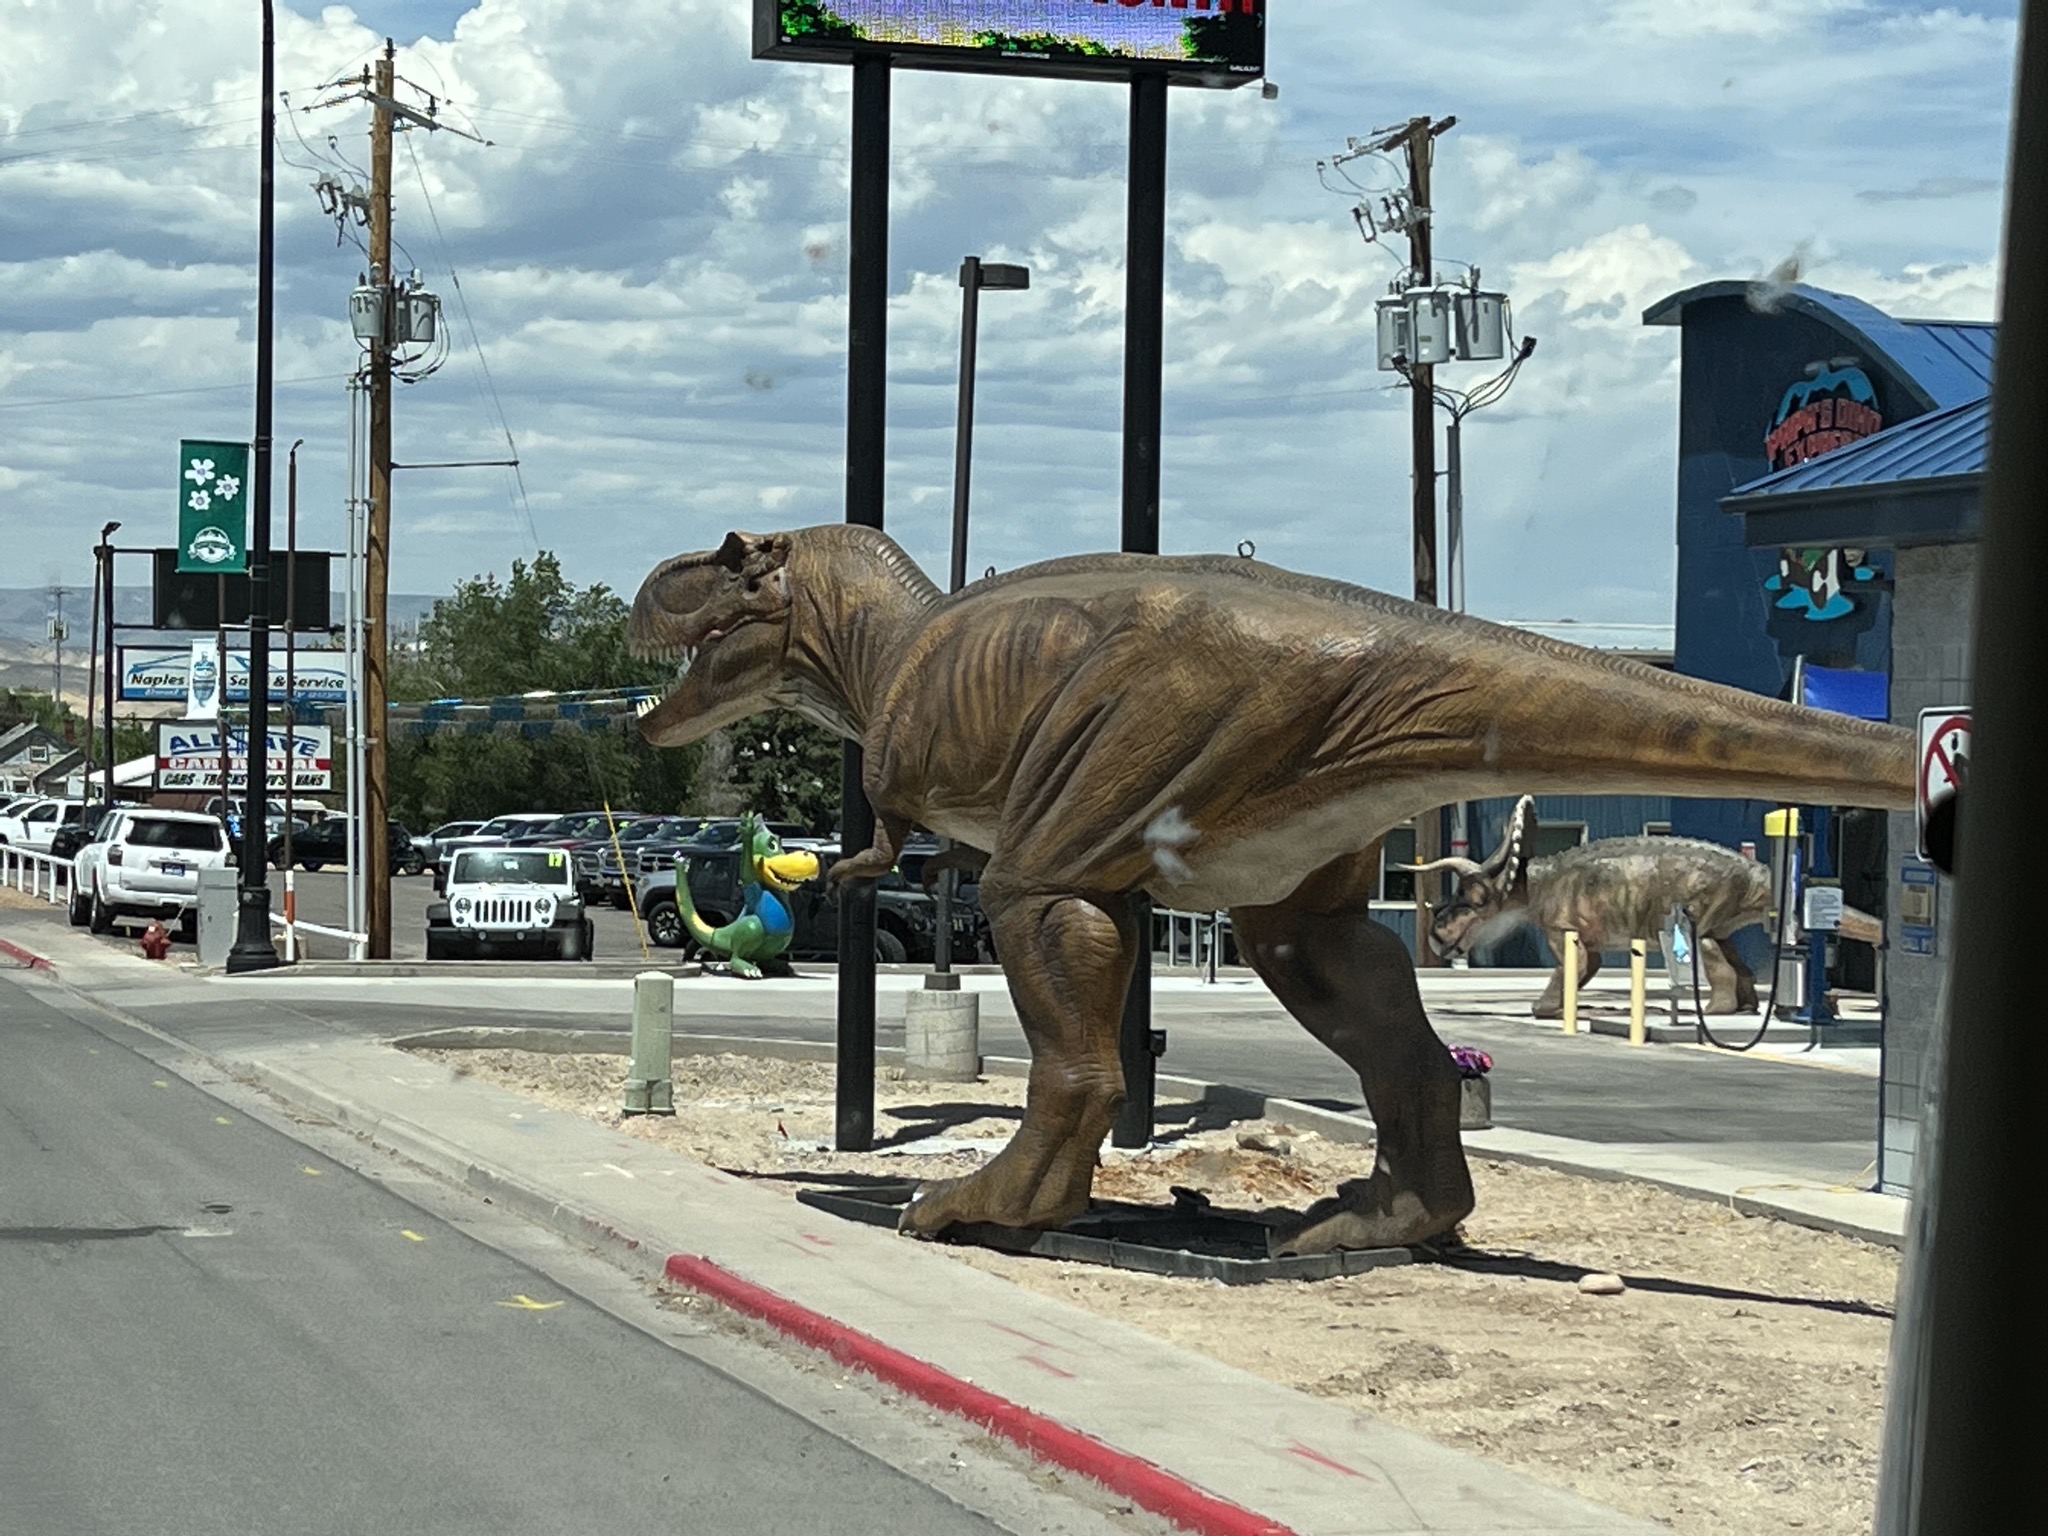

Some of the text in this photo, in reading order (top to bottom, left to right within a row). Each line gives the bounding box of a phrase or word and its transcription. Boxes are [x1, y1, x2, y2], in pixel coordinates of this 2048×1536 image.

[130, 673, 186, 688] Naples
[273, 675, 286, 687] &
[168, 758, 317, 770] CAR RNTAL
[164, 773, 196, 786] CARS
[294, 773, 325, 786] VANS
